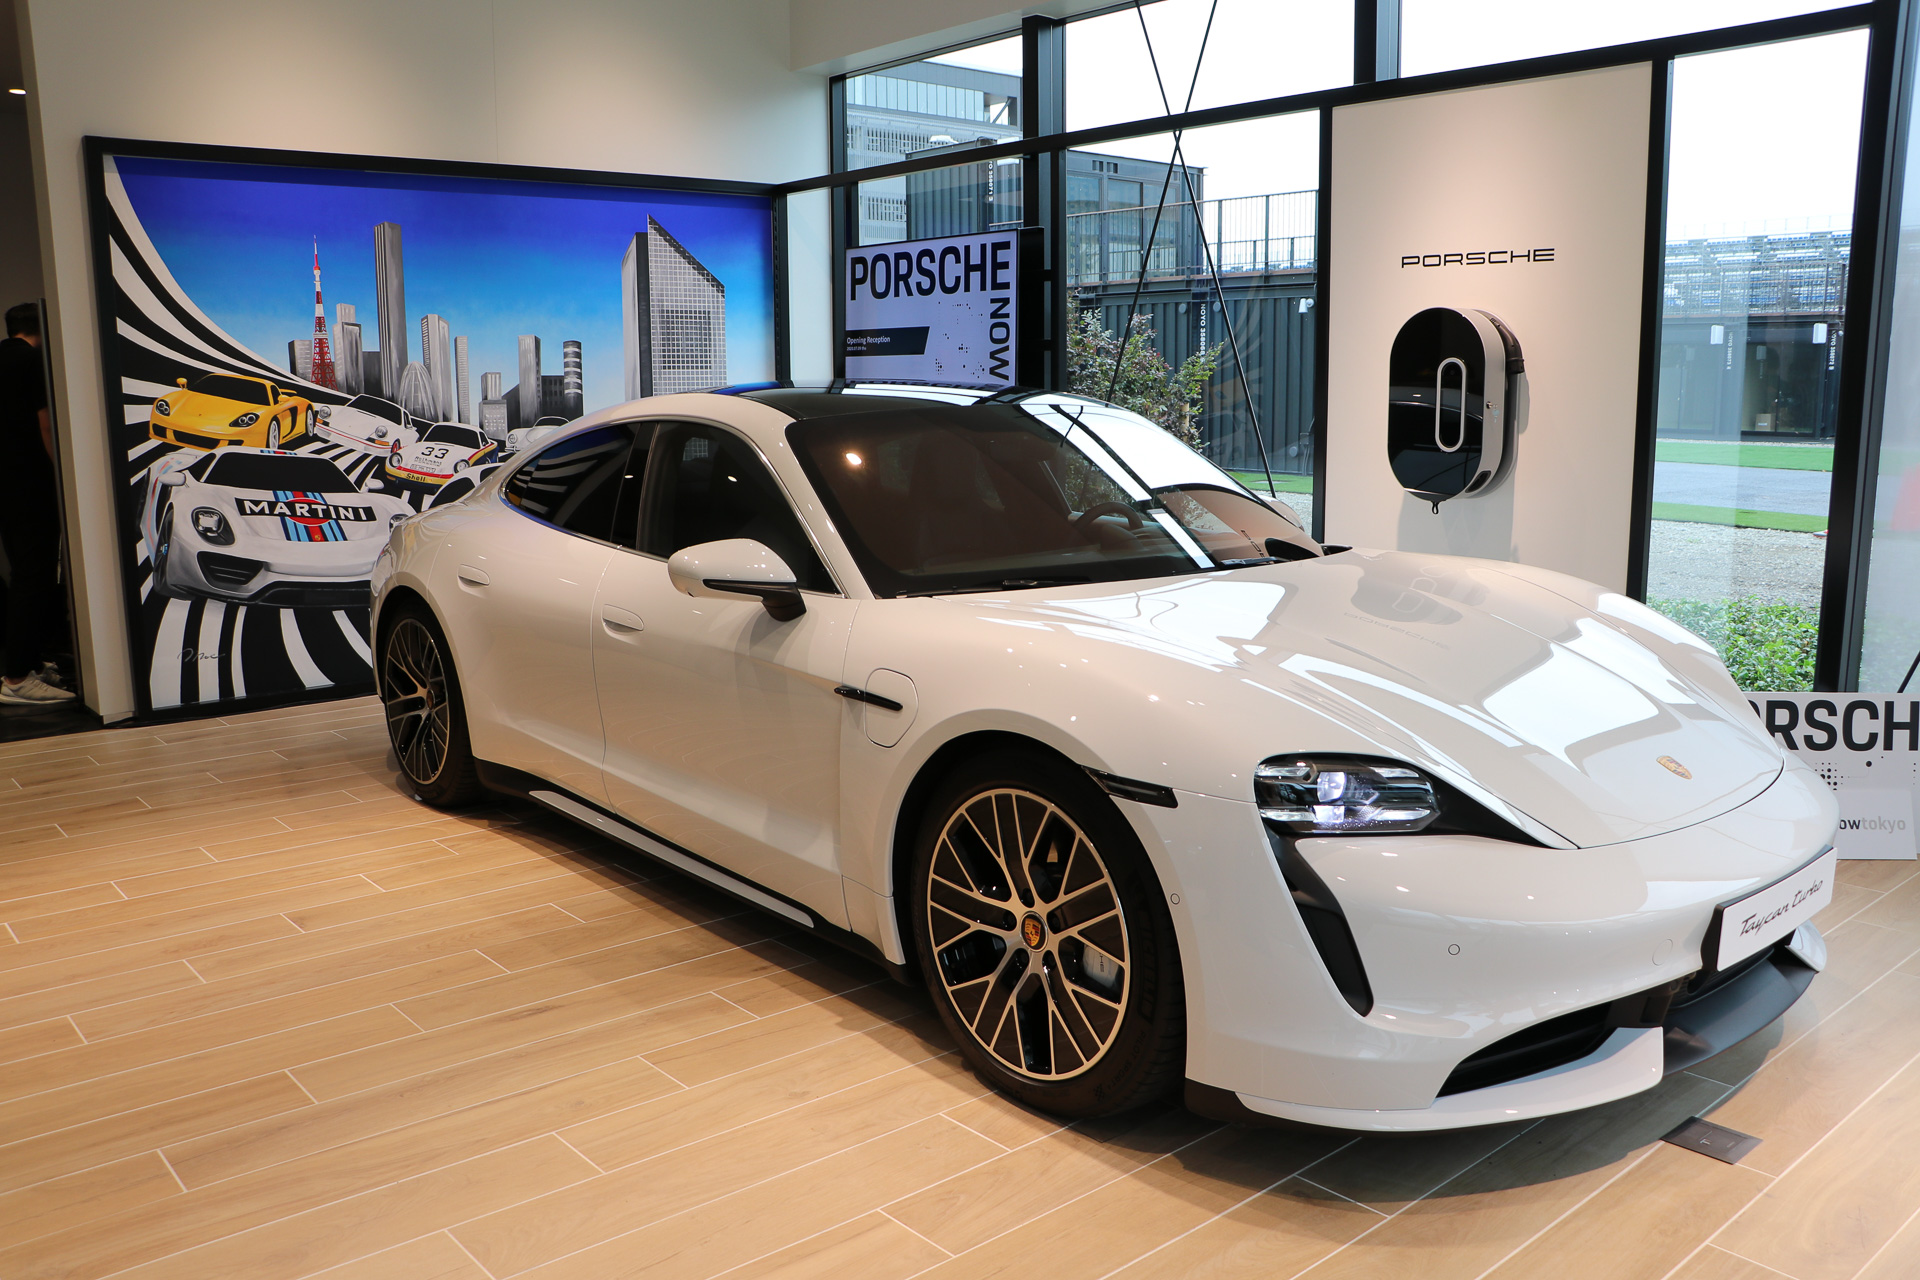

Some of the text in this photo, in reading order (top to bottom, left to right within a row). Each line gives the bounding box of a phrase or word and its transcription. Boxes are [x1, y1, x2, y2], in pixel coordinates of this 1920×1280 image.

[1401, 247, 1555, 269] PORSCHE
[849, 240, 1011, 301] PORSCHE
[846, 335, 891, 346] Opening Reception
[988, 297, 1011, 381] NOW
[420, 446, 450, 460] 33
[405, 472, 427, 482] Shell
[243, 498, 370, 522] MARTINI
[1739, 879, 1824, 937] Taycan turbo
